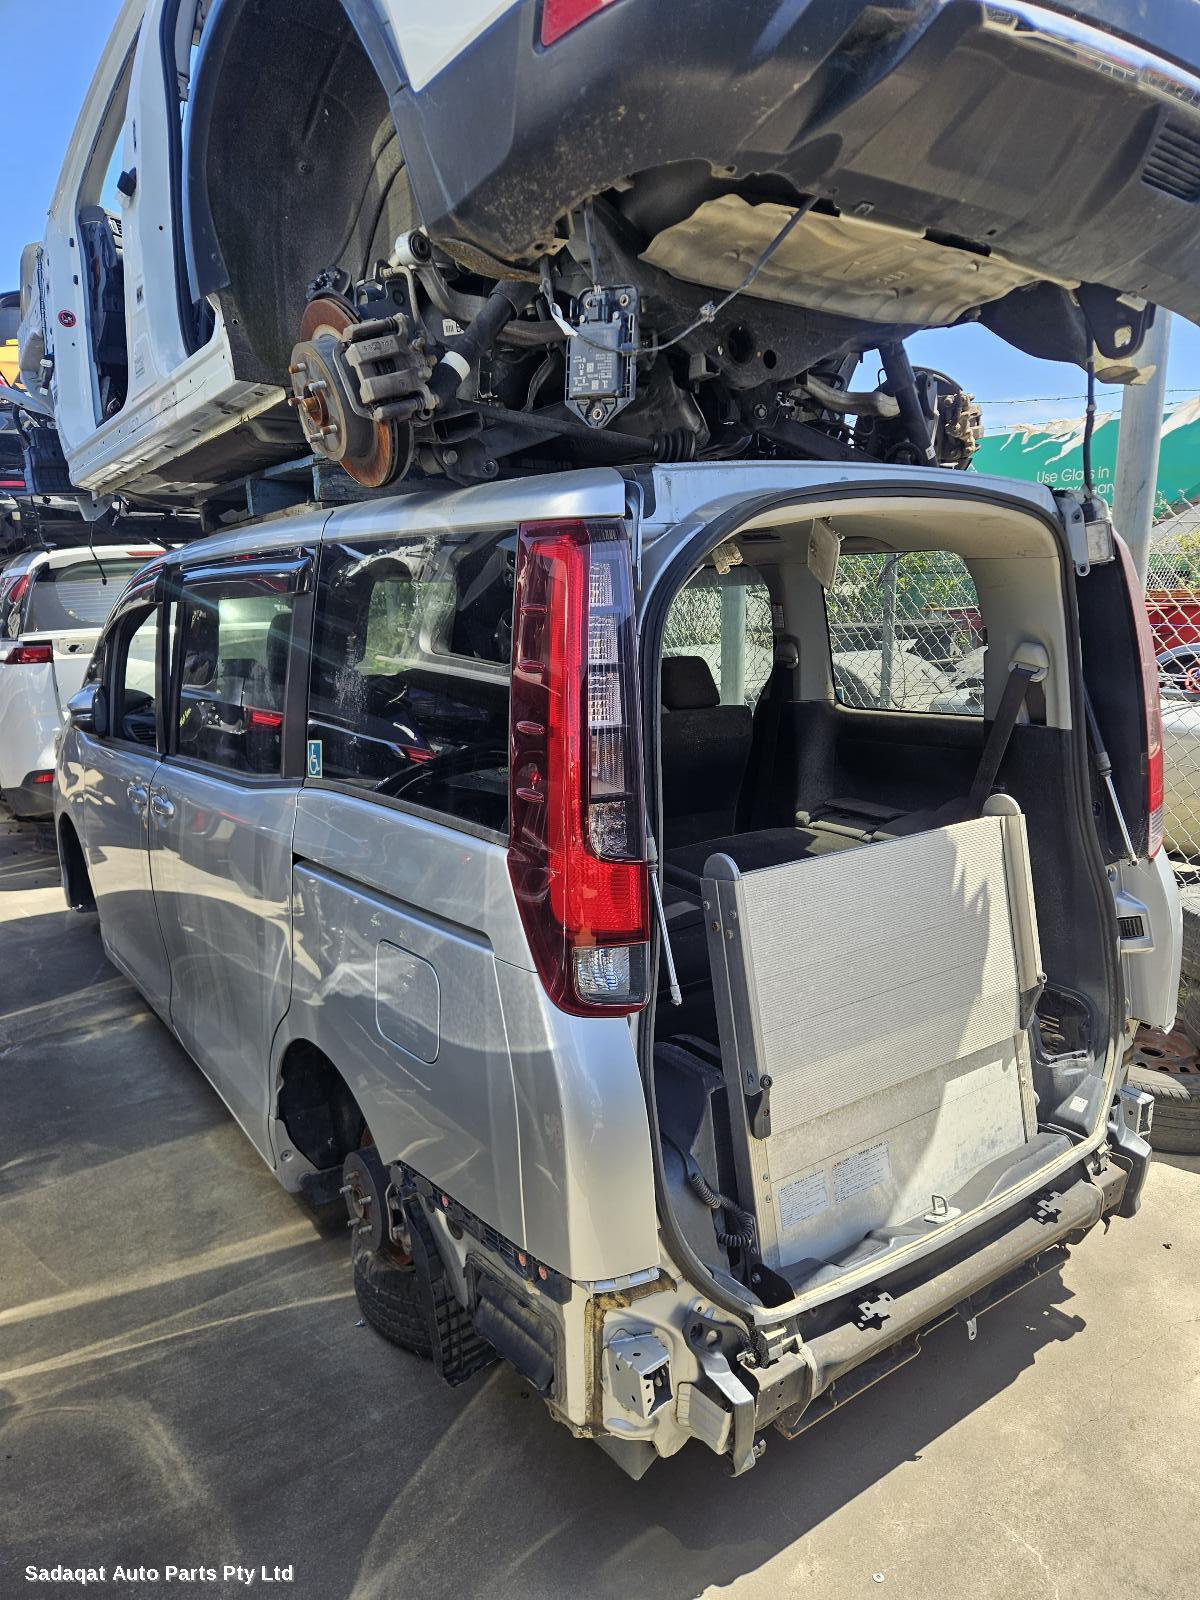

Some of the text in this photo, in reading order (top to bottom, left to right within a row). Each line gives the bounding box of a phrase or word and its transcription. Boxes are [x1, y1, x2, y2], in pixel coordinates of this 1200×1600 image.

[1036, 466, 1109, 483] Use Glas in
